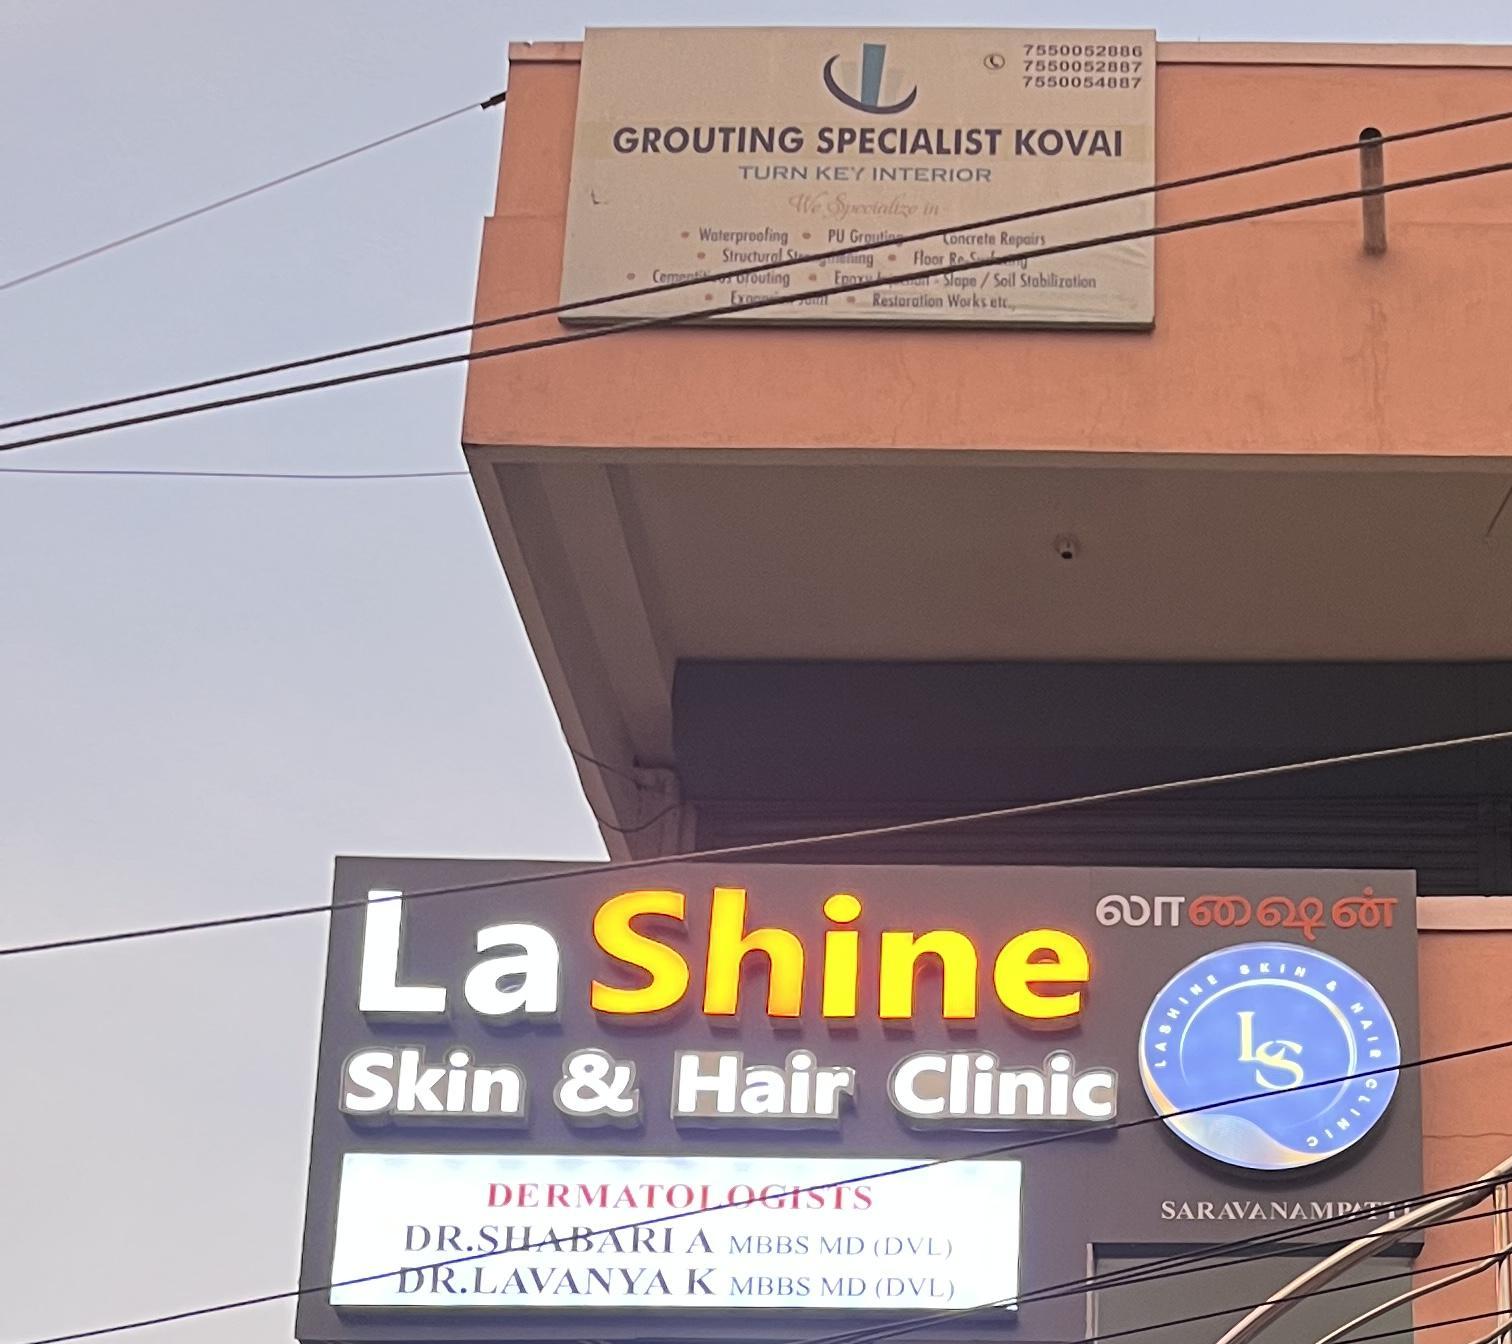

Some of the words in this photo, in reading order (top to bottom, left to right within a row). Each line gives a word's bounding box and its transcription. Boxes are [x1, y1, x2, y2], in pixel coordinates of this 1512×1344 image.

[1023, 44, 1143, 57] 7550052886
[1023, 60, 1143, 73] 7550052887
[1022, 76, 1142, 89] 7550054887
[612, 126, 804, 155] GROUTING
[816, 127, 1001, 156] SPECIALIST
[1014, 128, 1123, 157] KOVAI
[738, 165, 808, 181] TURN
[816, 165, 865, 181] KEY
[872, 166, 992, 183] INTERIOR
[827, 191, 918, 221] Specialize
[699, 227, 789, 246] Waterproofing
[828, 228, 845, 243] PU
[943, 231, 996, 246] Concrete
[1000, 231, 1046, 248] Repairs
[723, 248, 783, 264] Structural
[914, 250, 944, 266] Floor
[736, 271, 790, 288] Grouting
[994, 273, 1015, 288] Soil
[1020, 274, 1097, 289] Stabilization
[872, 293, 943, 308] Restoration
[948, 294, 986, 309] Works
[358, 889, 558, 1015] La
[590, 887, 1090, 1020] Shine
[1238, 962, 1307, 978] SKIN
[1237, 1011, 1304, 1090] LS
[345, 1049, 520, 1114] Skin
[559, 1053, 634, 1113] &
[677, 1053, 855, 1116] Hair
[894, 1054, 1114, 1119] Clinic
[487, 1183, 873, 1211] DERMATOLOGISTS
[404, 1224, 674, 1254] DR.SHABARI
[685, 1227, 715, 1254] A
[728, 1235, 810, 1255] MBBS
[820, 1236, 866, 1256] MD
[873, 1236, 953, 1259] (DVL)
[395, 1266, 673, 1296] DR.LAVANYA
[686, 1268, 717, 1296] K
[730, 1277, 811, 1297] MBBS
[821, 1277, 867, 1297] MD
[875, 1277, 955, 1302] (DVL)
